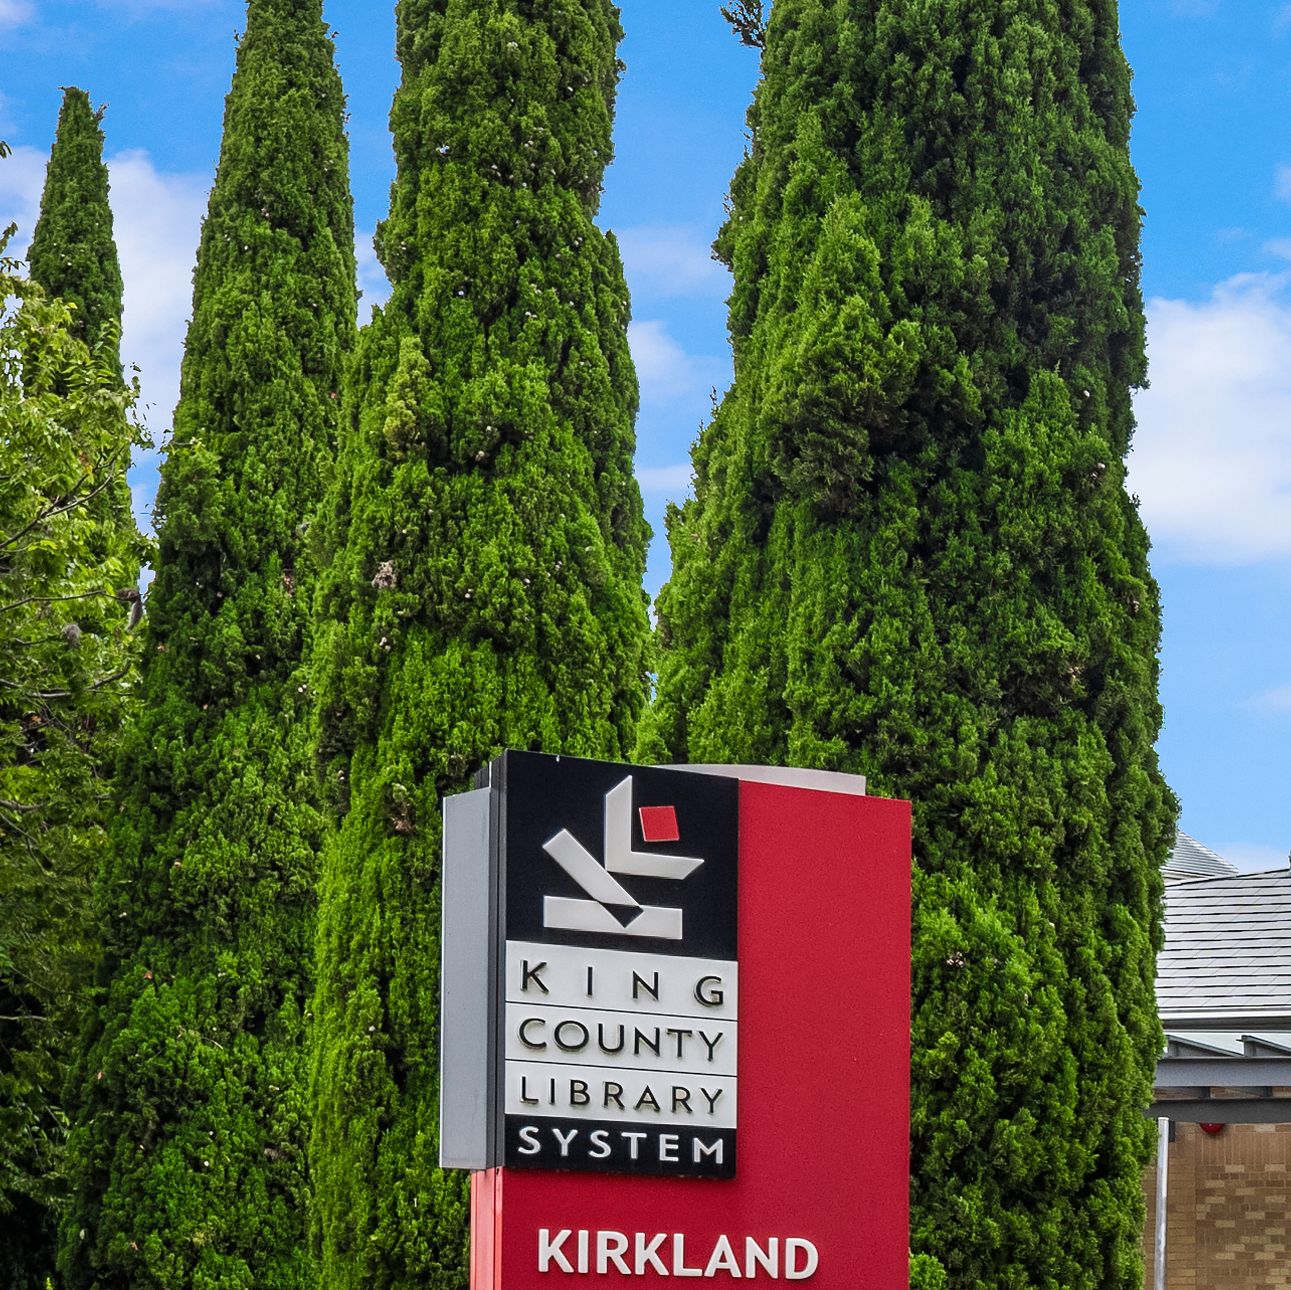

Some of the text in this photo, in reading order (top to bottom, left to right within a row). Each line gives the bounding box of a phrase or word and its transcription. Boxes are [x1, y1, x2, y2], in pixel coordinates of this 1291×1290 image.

[520, 959, 724, 1007] KING
[518, 1017, 723, 1062] COUNTY
[520, 1076, 723, 1114] LIBRARY
[518, 1126, 723, 1164] SYSTEM
[538, 1228, 819, 1280] KIRKLAND
